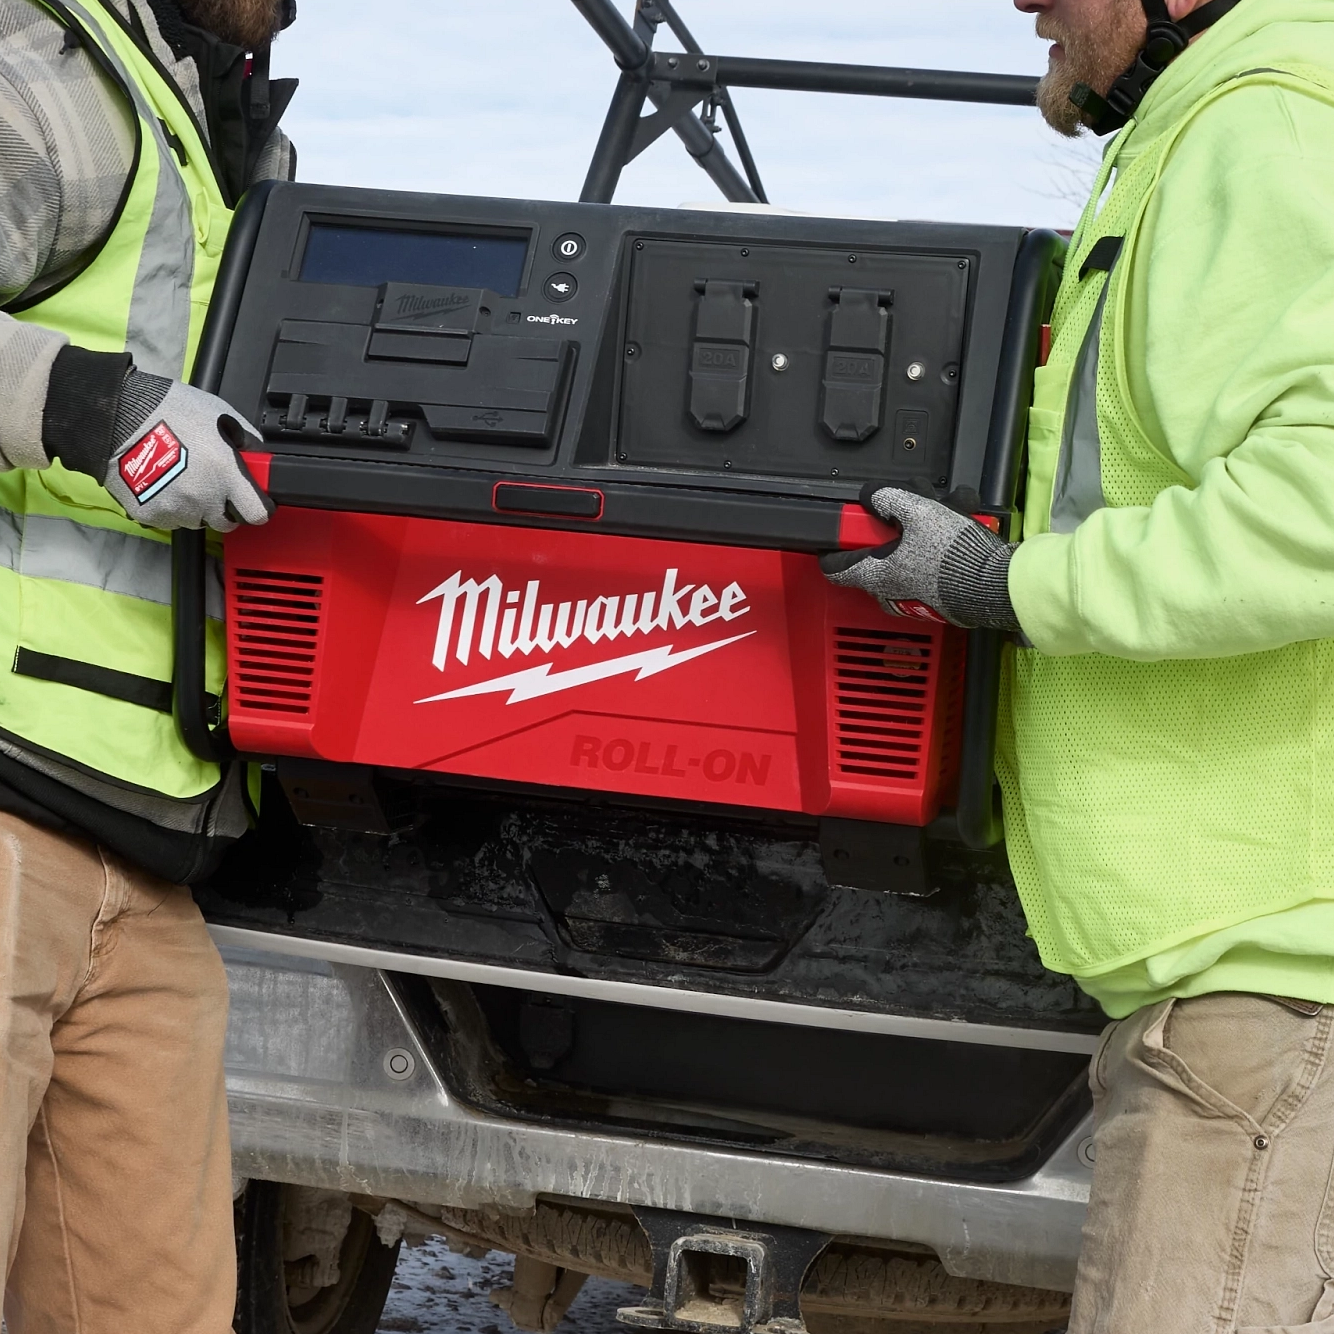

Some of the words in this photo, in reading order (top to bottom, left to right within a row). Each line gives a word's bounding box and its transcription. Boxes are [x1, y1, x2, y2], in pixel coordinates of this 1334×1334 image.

[395, 292, 470, 314] Milwaukee
[701, 351, 737, 367] 20A
[836, 361, 871, 377] 20A
[415, 568, 751, 672] Milwaukee
[569, 734, 772, 786] ROLL-ON
